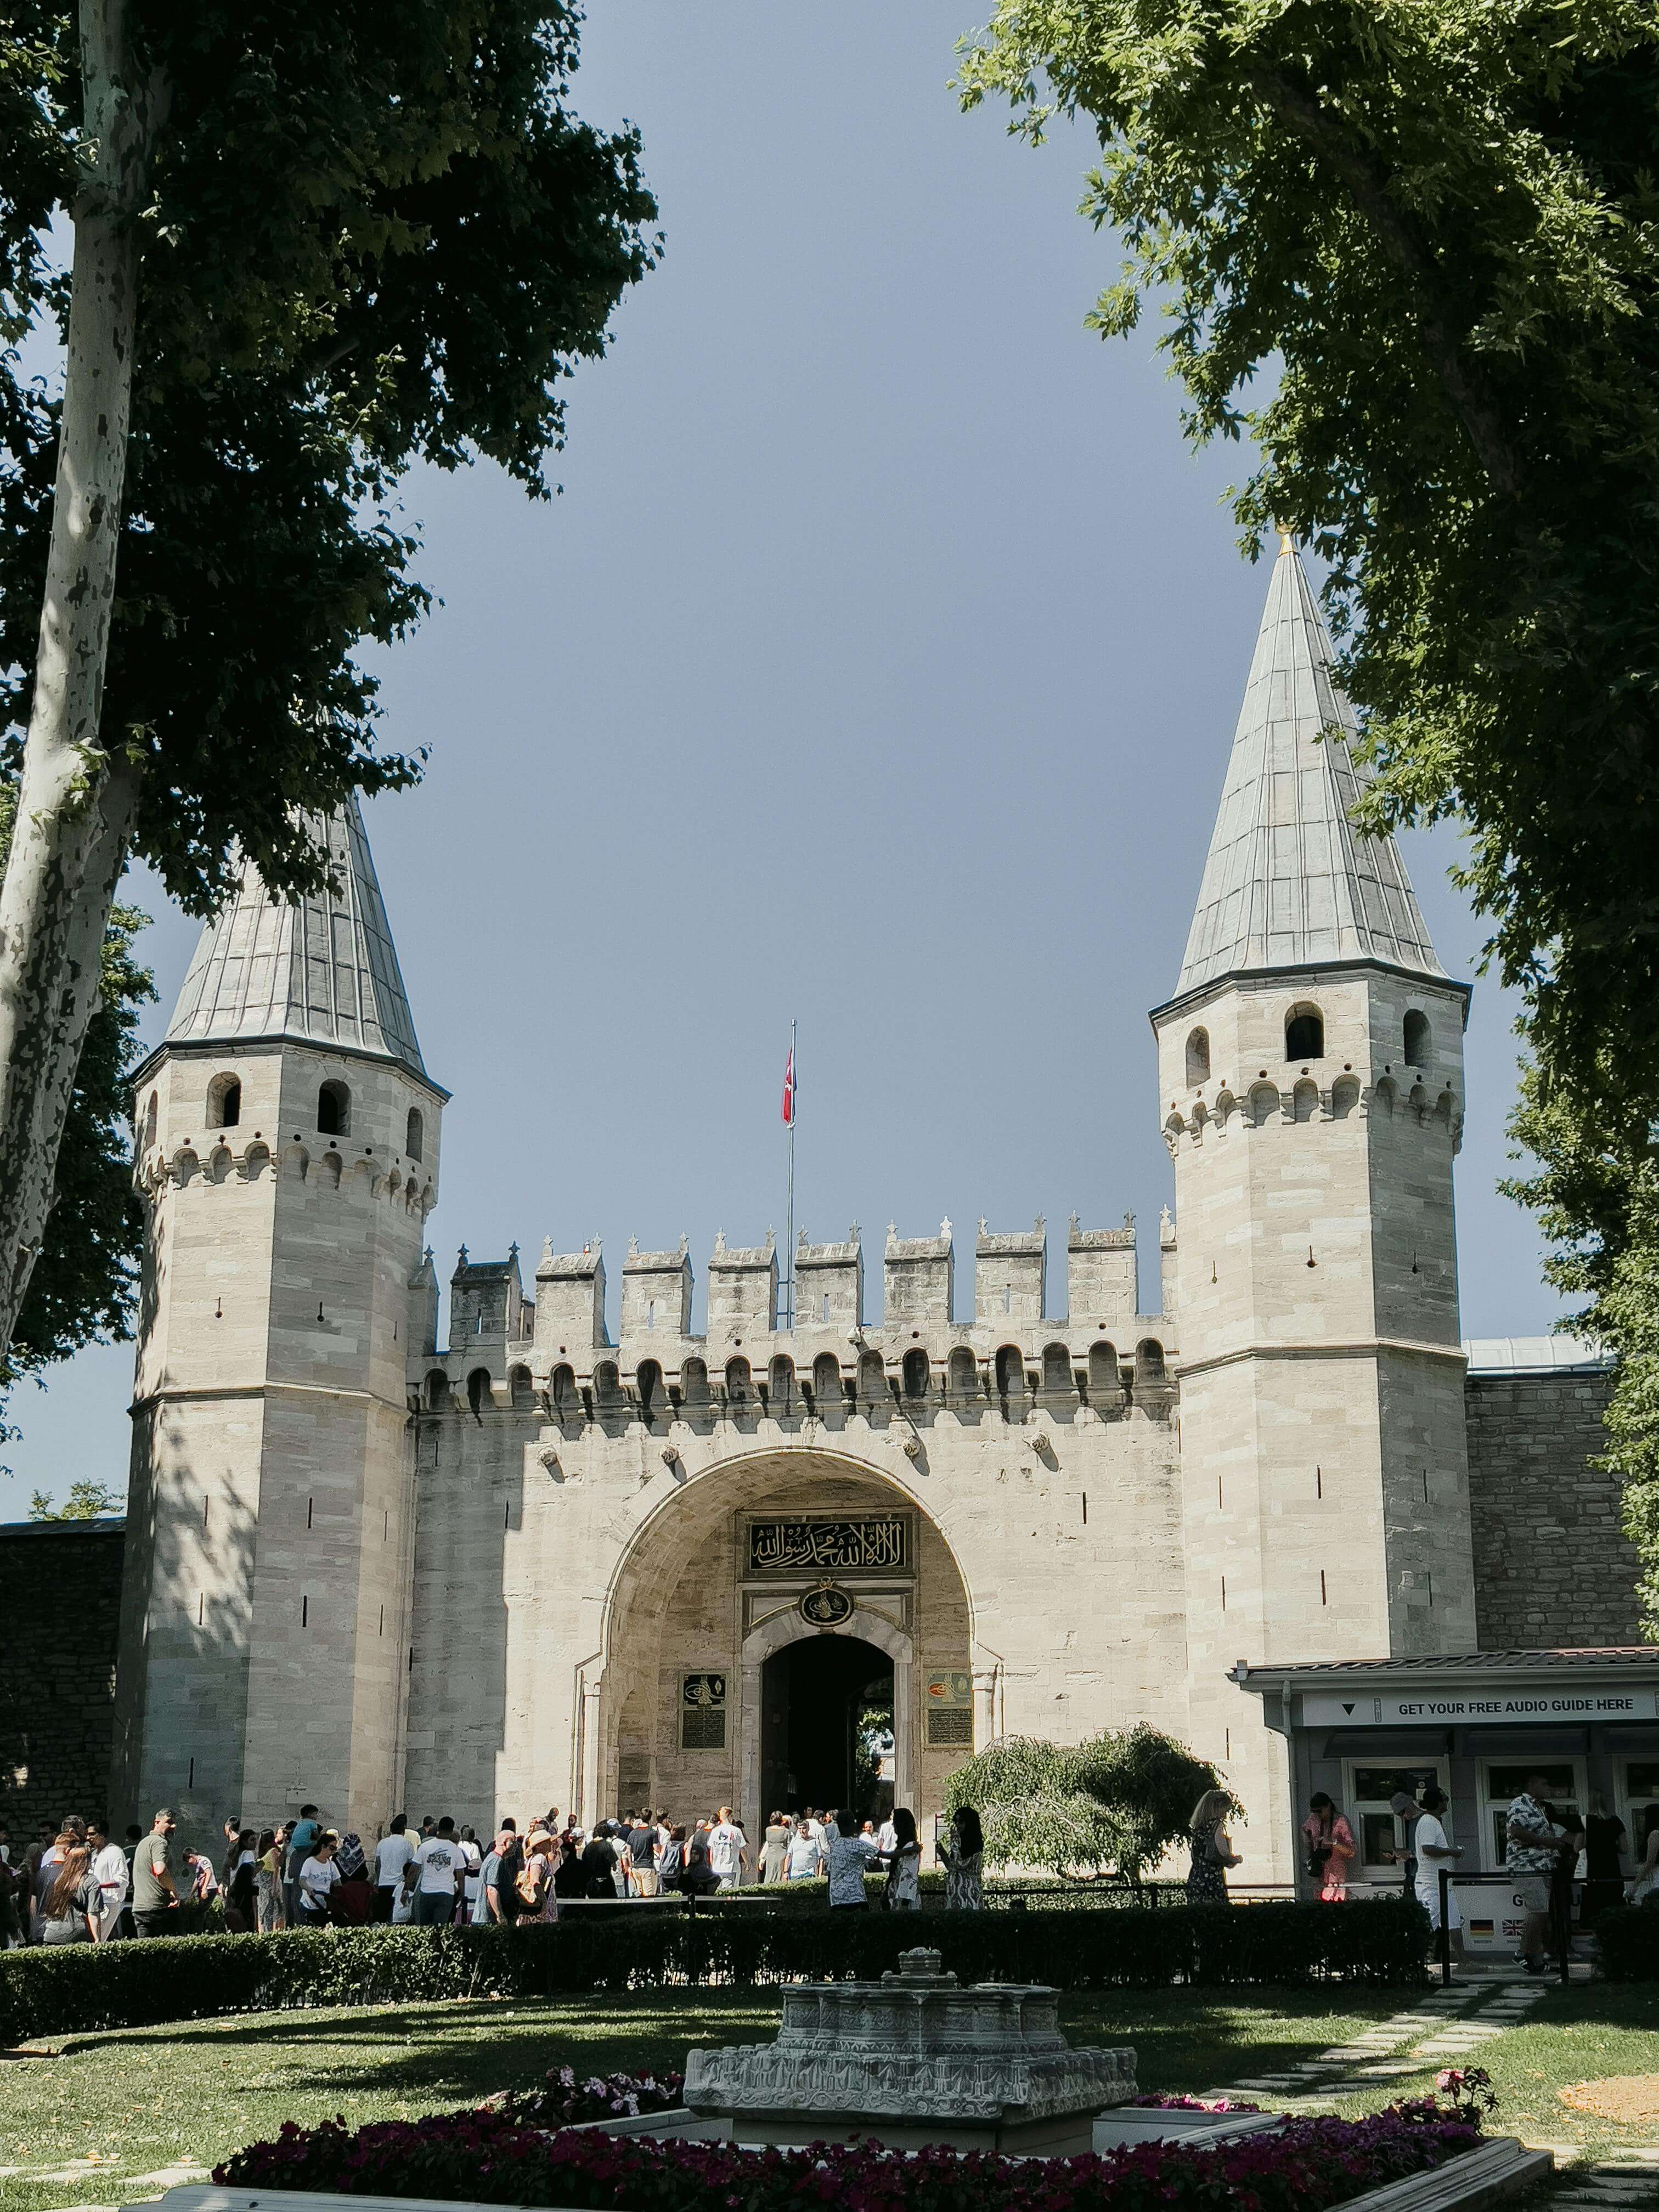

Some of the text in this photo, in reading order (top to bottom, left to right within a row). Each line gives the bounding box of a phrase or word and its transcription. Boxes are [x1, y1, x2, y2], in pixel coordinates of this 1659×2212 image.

[1398, 1699, 1634, 1715] GET YOUR FREE AUDIO GUIDE HERE
